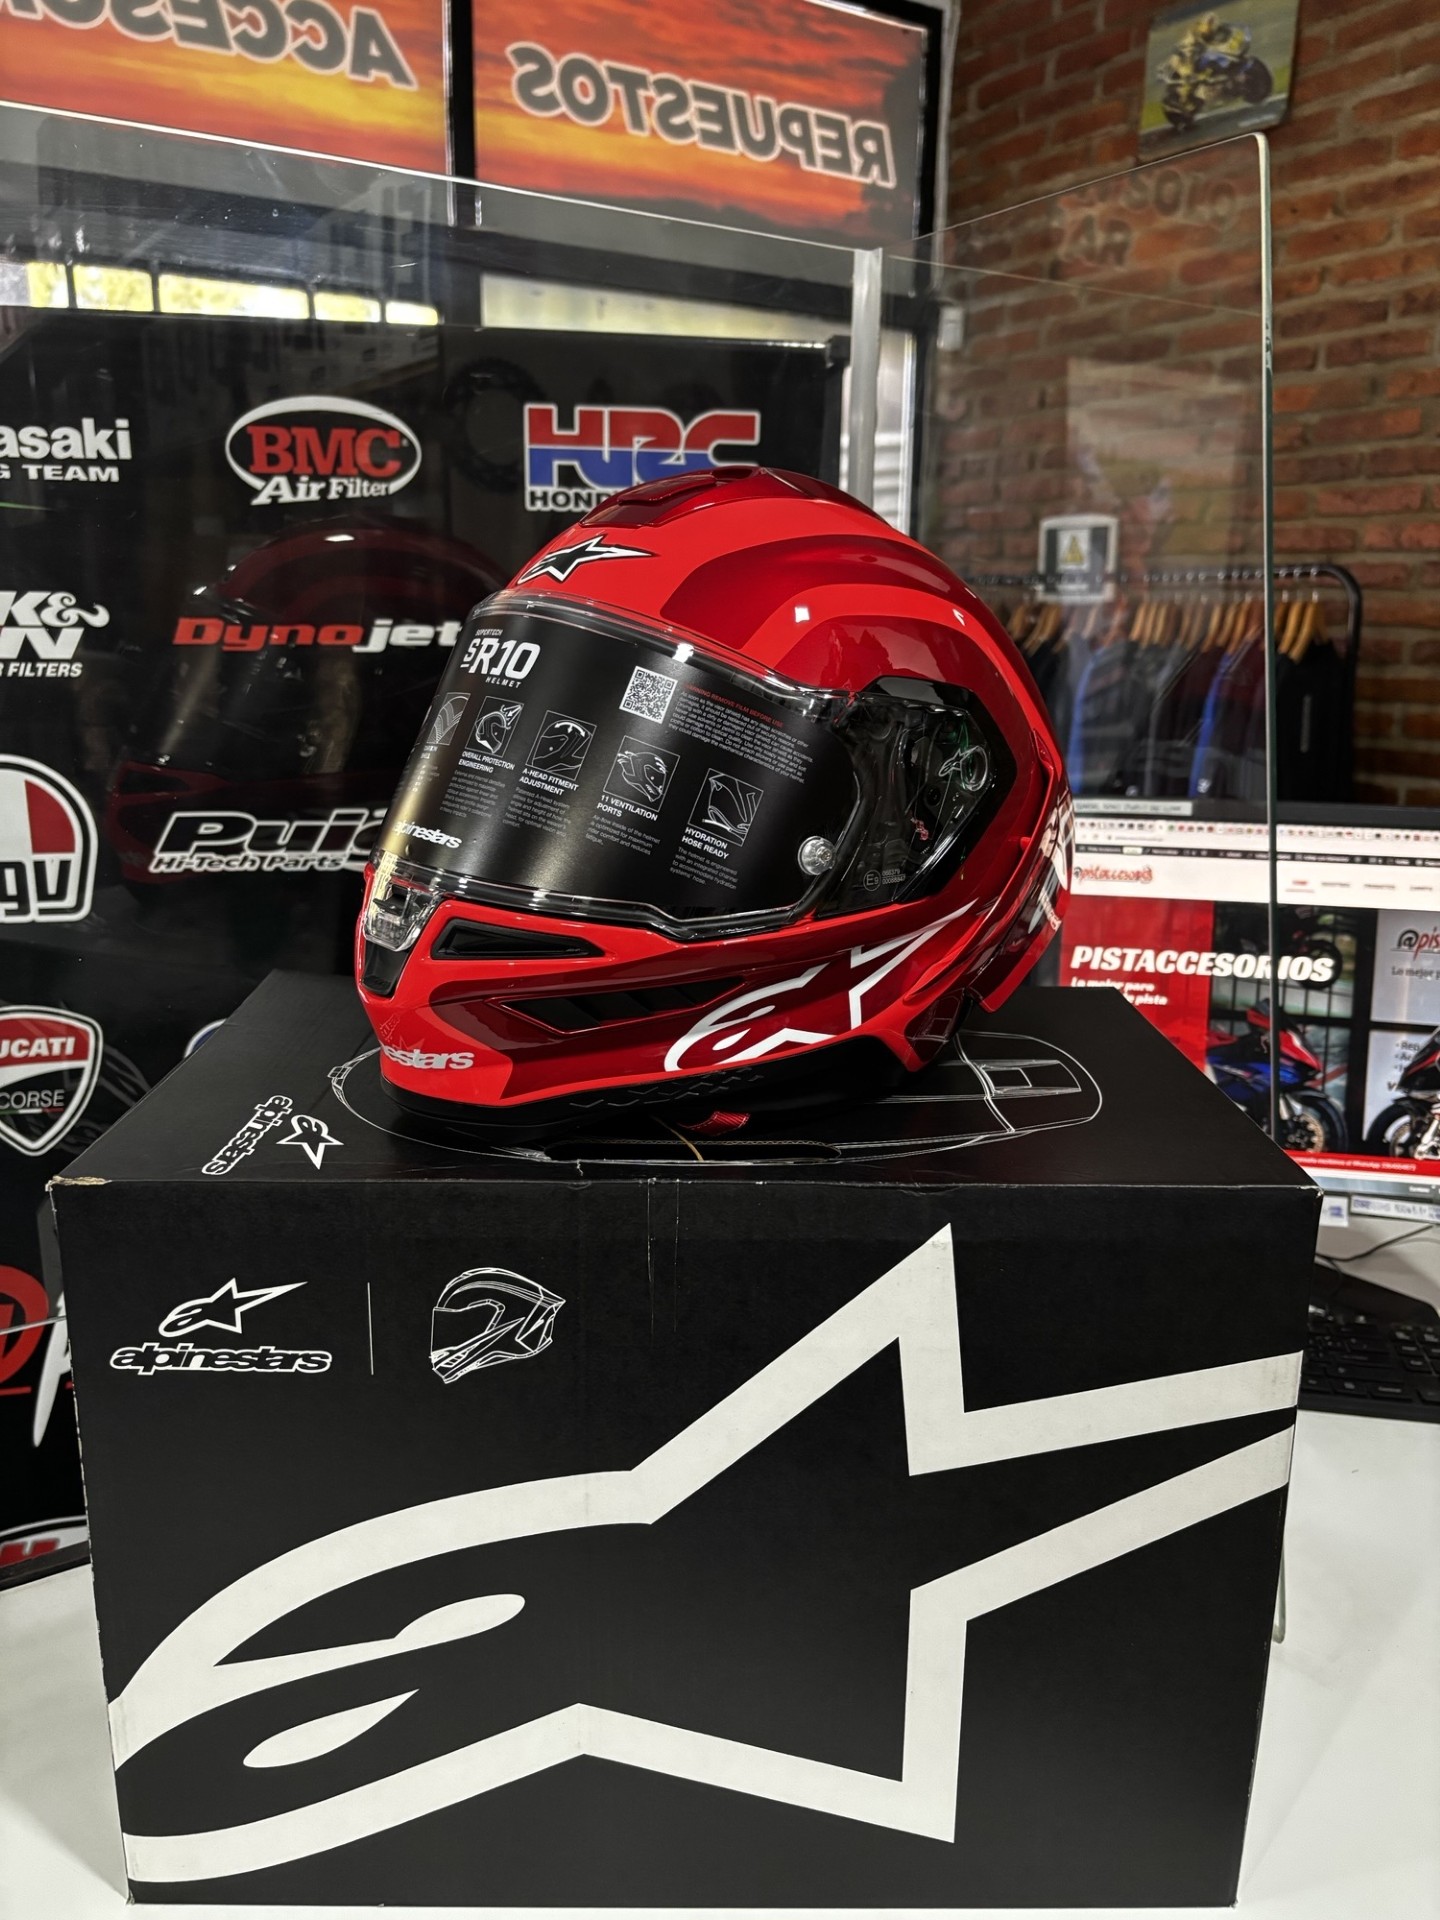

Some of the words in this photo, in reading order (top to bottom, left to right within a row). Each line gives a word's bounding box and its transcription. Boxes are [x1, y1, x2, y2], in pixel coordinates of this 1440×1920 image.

[247, 425, 402, 477] BMC
[524, 403, 761, 488] HRC
[21, 464, 120, 482] TEAM
[251, 476, 326, 505] Air
[327, 478, 392, 500] Filter
[172, 617, 462, 653] Dynojet
[7, 662, 83, 678] FILTERS
[485, 676, 522, 689] HELMET
[458, 758, 494, 774] ENGINEERING
[482, 755, 515, 771] PROTECTION
[519, 776, 565, 796] ADJUSTMENT
[522, 768, 548, 780] A-HEAD
[548, 775, 580, 791] FITMENT
[597, 802, 623, 818] PORTS
[601, 794, 610, 802] 11
[610, 797, 659, 821] VENTILATION
[681, 835, 704, 850] HOSE
[703, 845, 730, 860] READY
[684, 826, 728, 850] HYDRATION
[149, 852, 260, 873] Hi-Tech
[263, 852, 347, 873] Parts
[1070, 945, 1335, 982] PISTACCESORIOS
[0, 1089, 65, 1109] CORSE
[110, 1342, 332, 1375] alpinestars
